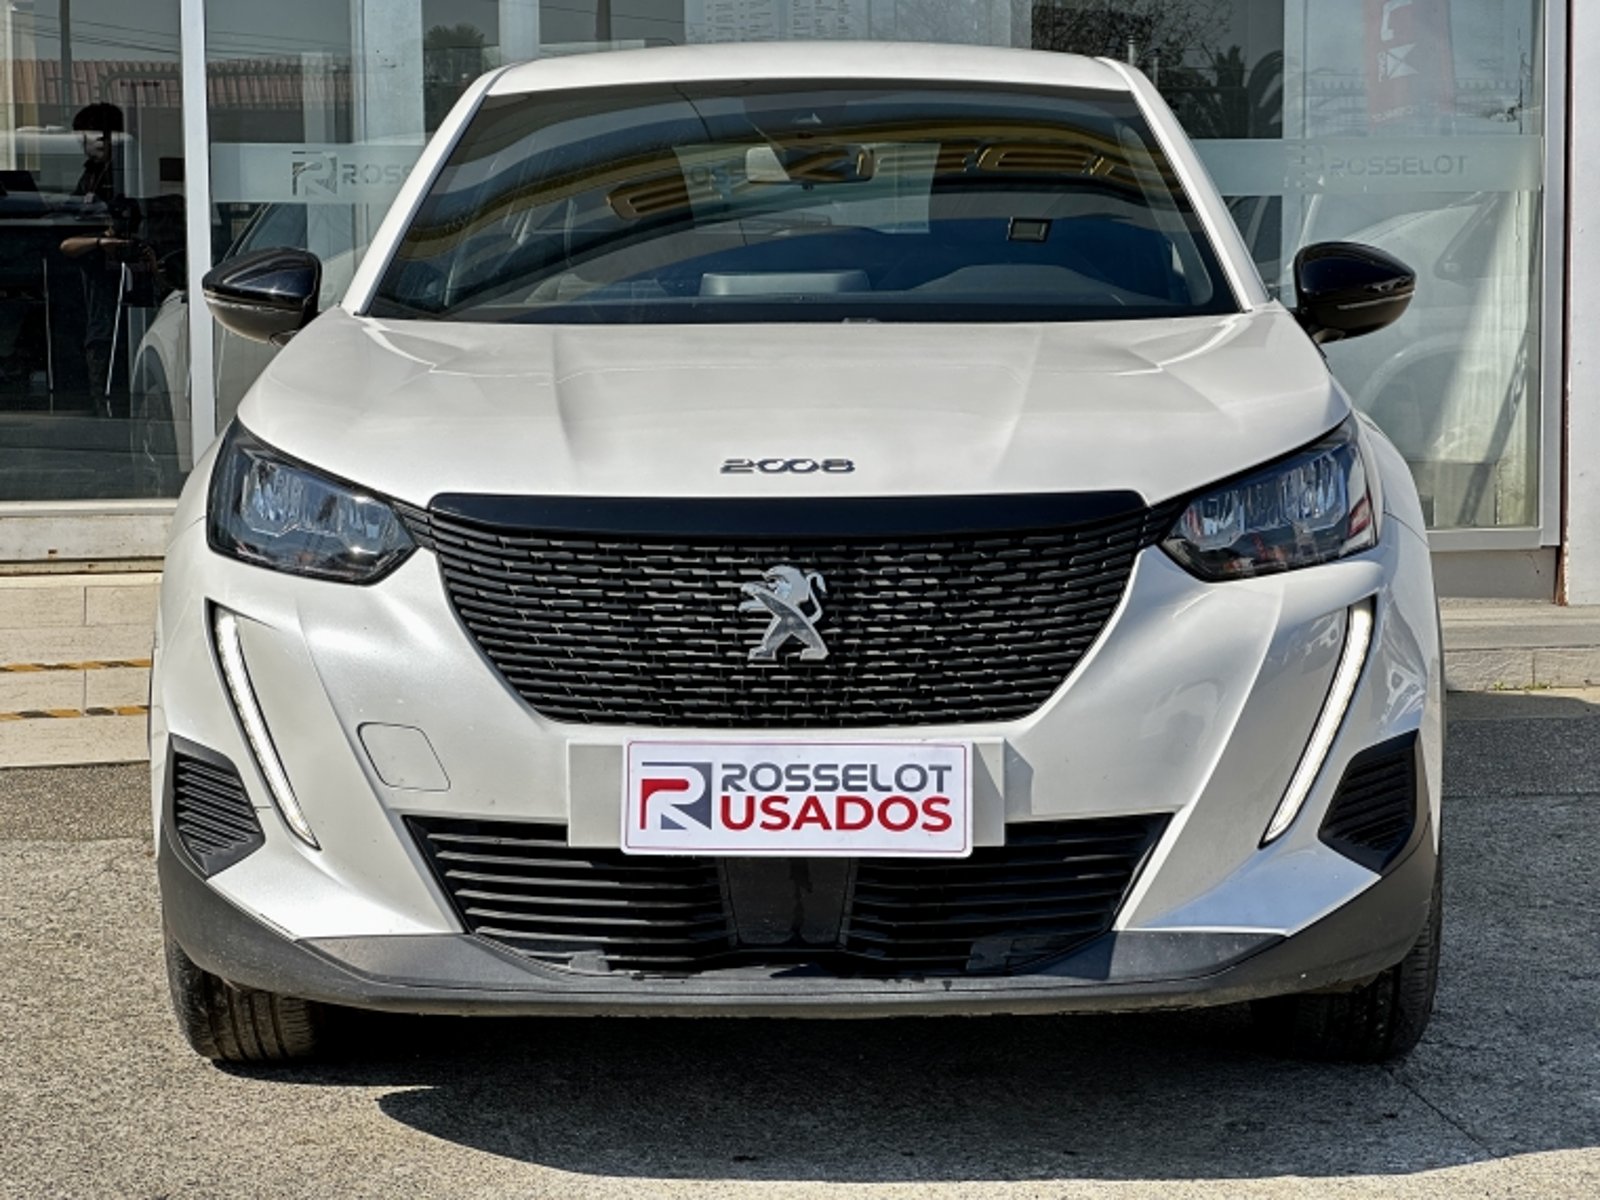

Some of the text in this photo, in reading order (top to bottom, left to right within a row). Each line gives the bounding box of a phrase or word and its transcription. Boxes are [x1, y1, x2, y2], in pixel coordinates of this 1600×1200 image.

[1329, 154, 1468, 176] ROSSELOT
[719, 458, 856, 474] 2008
[721, 762, 953, 793] ROSSELOT
[720, 795, 953, 833] USADOS
